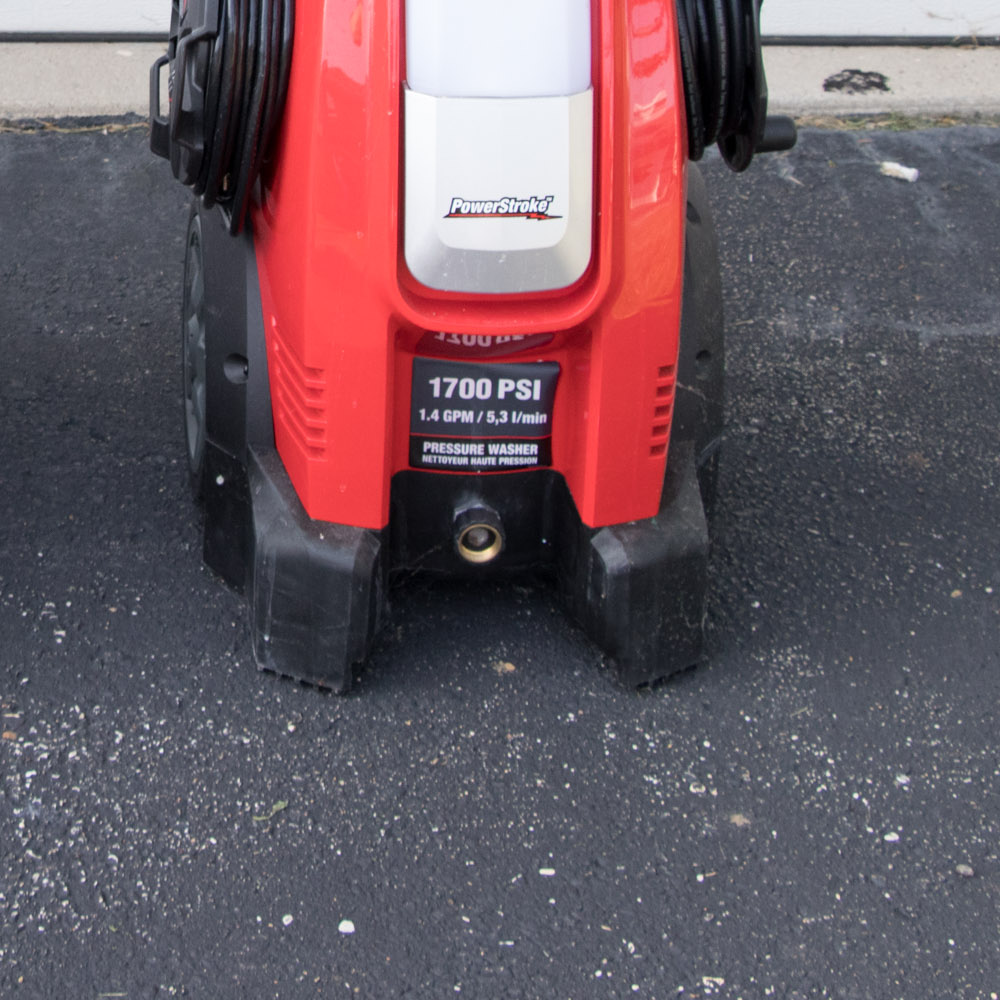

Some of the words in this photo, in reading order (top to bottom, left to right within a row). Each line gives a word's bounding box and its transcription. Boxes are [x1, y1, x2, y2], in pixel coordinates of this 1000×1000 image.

[449, 197, 550, 214] PowerStroke
[429, 377, 492, 399] 1700
[498, 379, 541, 400] PSI
[419, 408, 439, 421] 1.4
[443, 410, 474, 423] GPM
[477, 411, 483, 423] /
[487, 411, 508, 426] 5,3
[423, 441, 484, 455] PRESSURE
[488, 444, 538, 455] WASHER
[422, 455, 469, 464] NETTOYEUR
[470, 457, 497, 466] HAUTE
[499, 457, 538, 466] PRESSION
